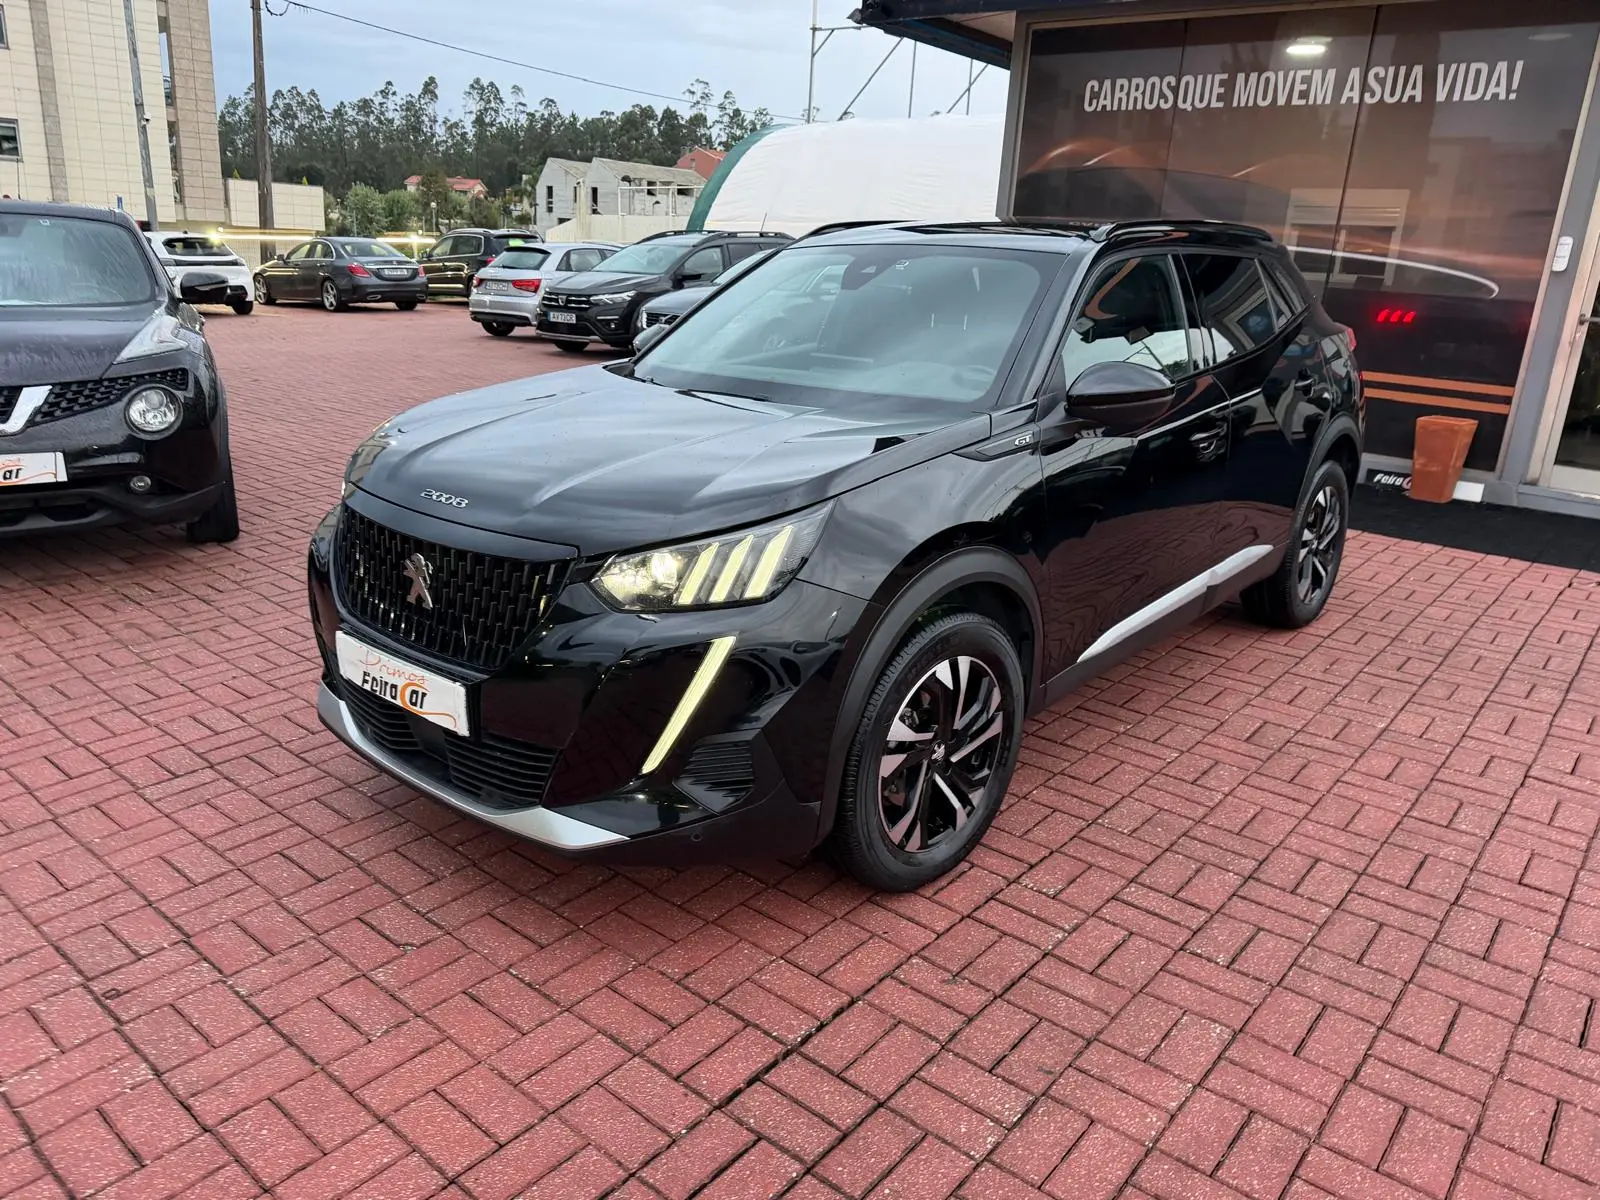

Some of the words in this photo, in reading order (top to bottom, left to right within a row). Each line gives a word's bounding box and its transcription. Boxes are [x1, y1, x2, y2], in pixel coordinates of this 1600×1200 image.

[1083, 75, 1177, 112] CARROS
[1177, 73, 1229, 112] QUE
[1232, 67, 1337, 107] MOVEM
[1339, 66, 1361, 105] A
[1364, 64, 1424, 104] SUA
[1435, 60, 1525, 103] VIDA!
[1014, 434, 1032, 447] GT
[420, 488, 469, 508] 2008
[361, 670, 433, 716] FeiraCar
